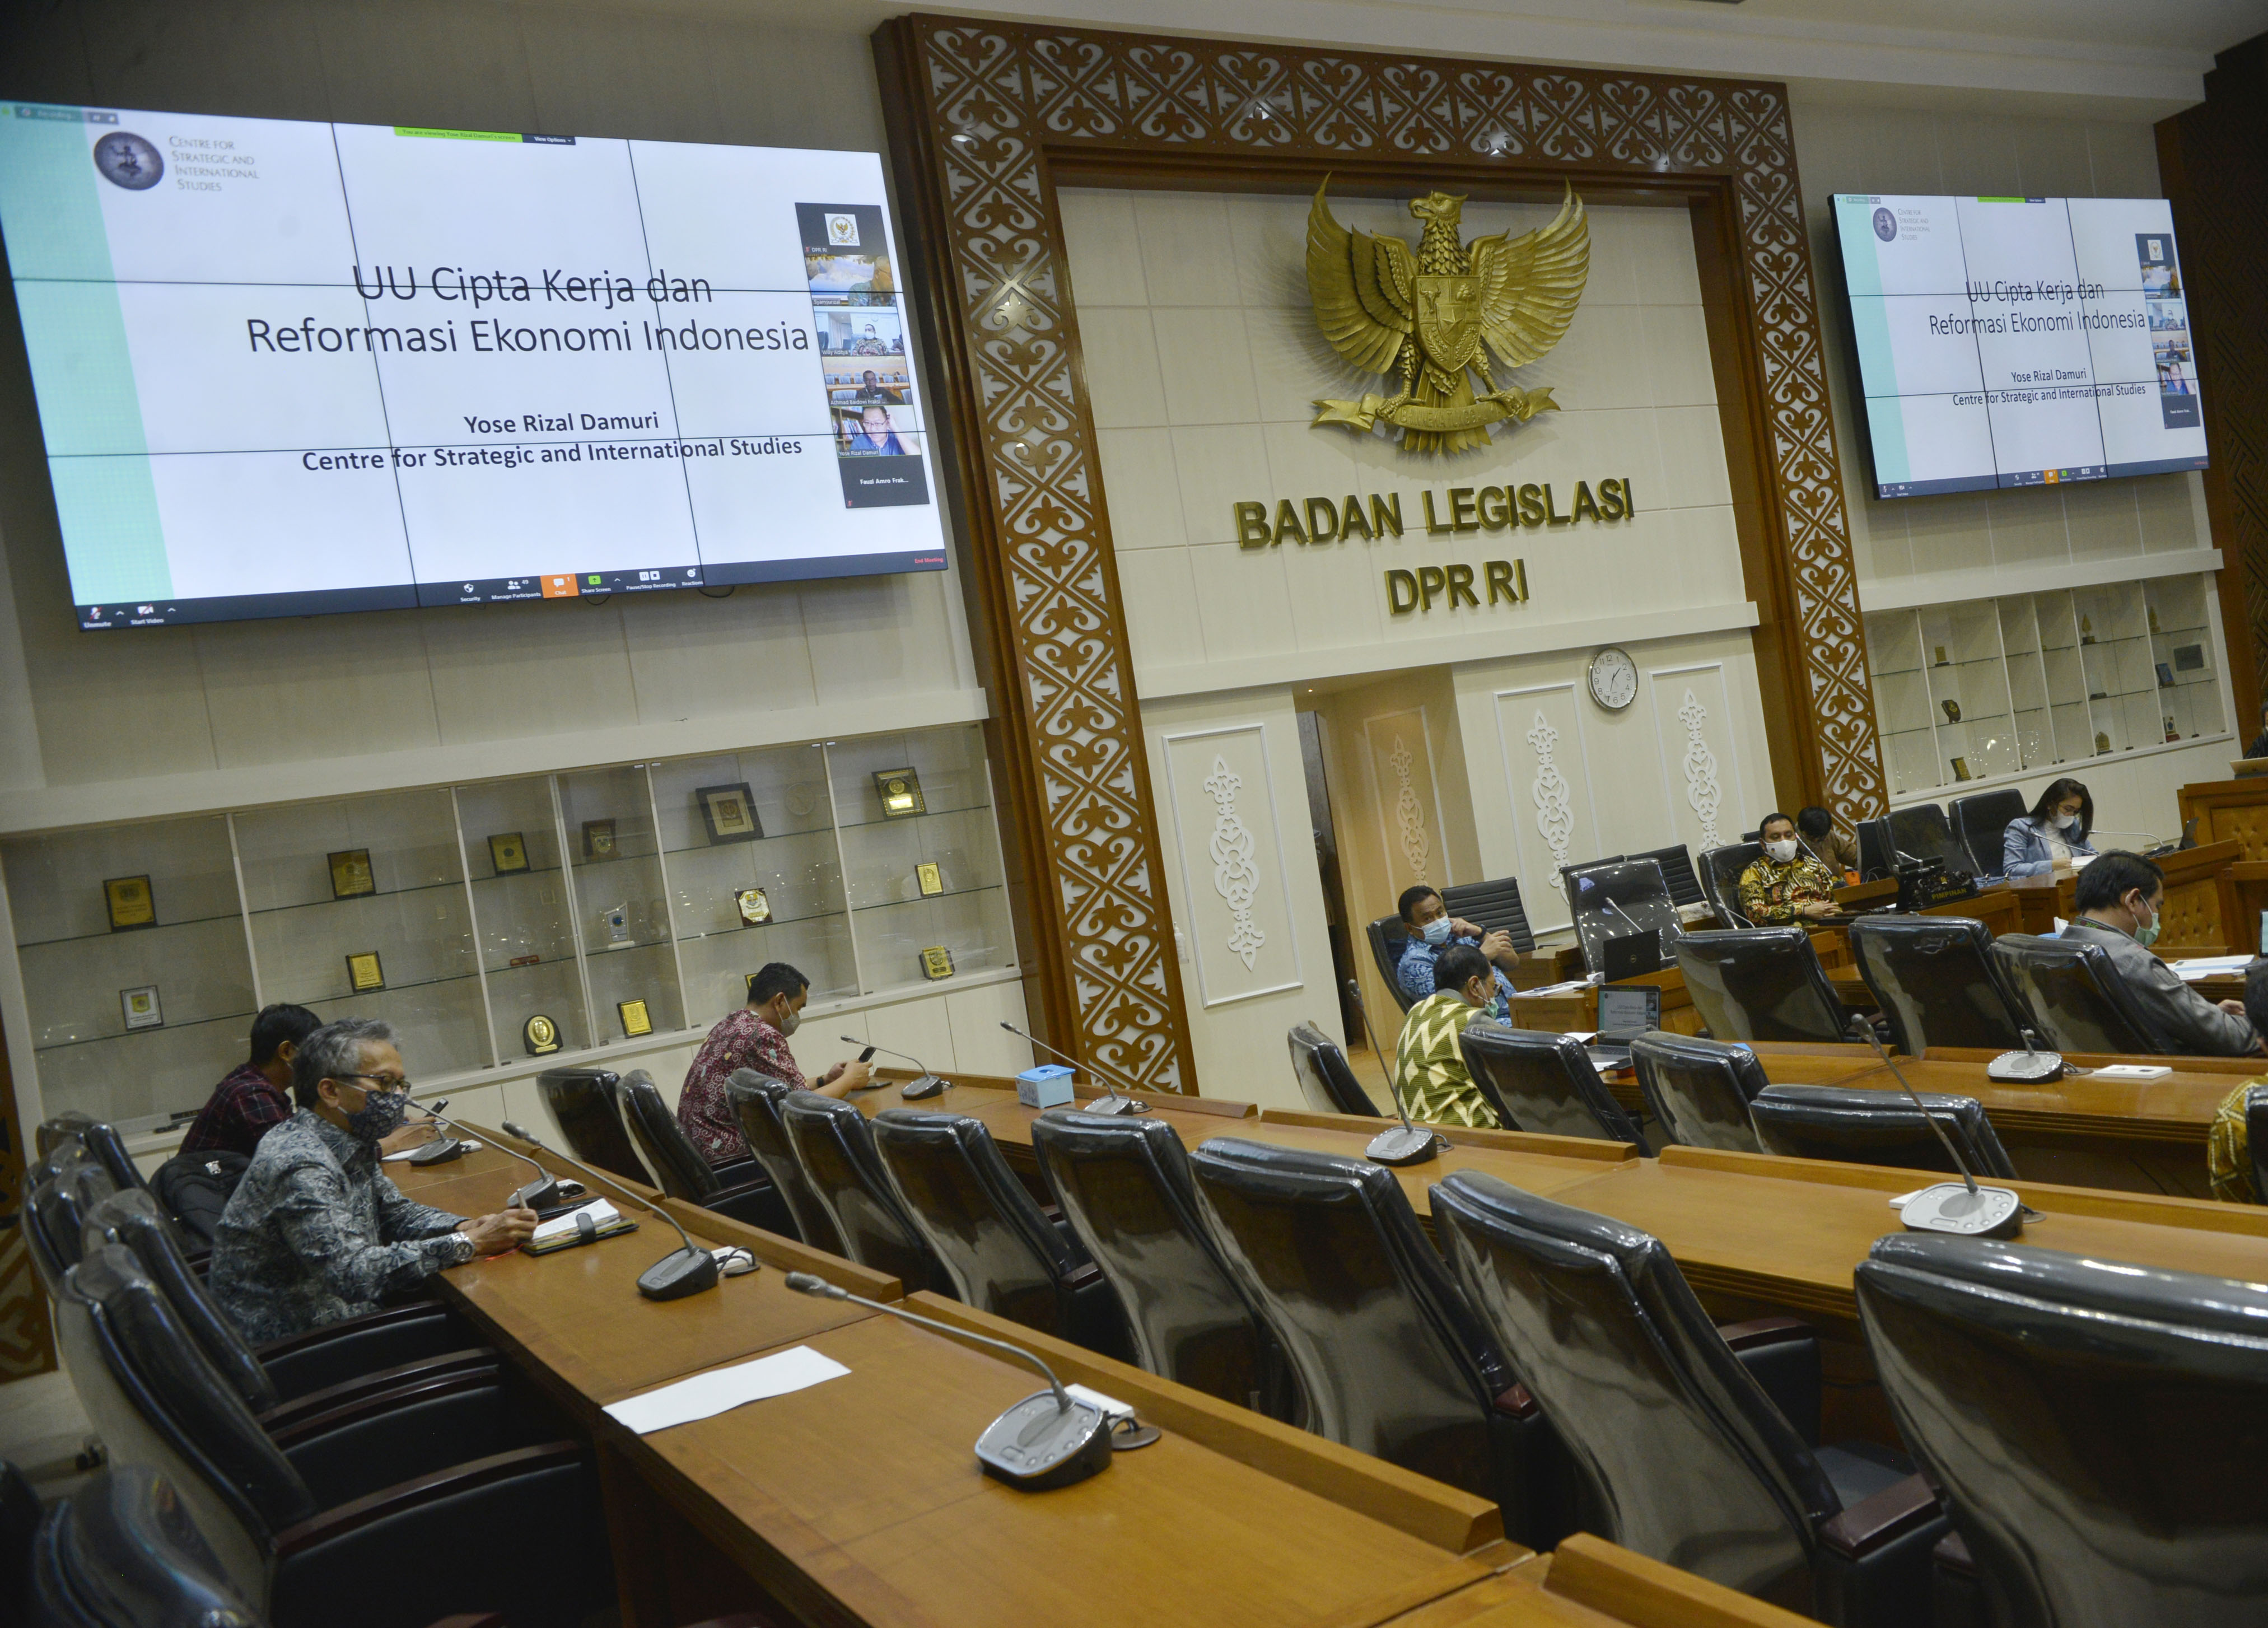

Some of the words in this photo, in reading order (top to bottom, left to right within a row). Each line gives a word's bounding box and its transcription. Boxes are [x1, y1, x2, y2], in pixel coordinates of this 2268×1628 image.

[213, 140, 234, 150] FOR
[232, 155, 254, 165] AND
[352, 265, 416, 300] UU
[431, 267, 530, 309] Cipta
[543, 269, 634, 310] Kerja
[647, 269, 712, 302] dan
[1966, 281, 1991, 302] UU
[1995, 280, 2033, 306] Cipta
[2036, 279, 2074, 305] Kerja
[2078, 278, 2104, 300] dan
[246, 316, 457, 352] Reformasi
[470, 318, 632, 352] Ekonomi
[643, 319, 809, 351] Indonesia
[1929, 313, 2007, 335] Reformasi
[2011, 311, 2074, 332] Ekonomi
[2077, 309, 2146, 330] Indonesia
[2011, 371, 2032, 383] Yose
[2033, 369, 2054, 382] Rizal
[2056, 367, 2087, 380] Damuri
[1953, 394, 1983, 406] Centre
[1985, 391, 1999, 404] for
[2001, 389, 2040, 404] Strategic
[2041, 388, 2057, 401] and
[2059, 385, 2115, 399] International
[2116, 383, 2146, 396] Studies
[463, 416, 516, 433] Yose
[523, 413, 573, 432] Rizal
[581, 412, 659, 431] Damuri
[302, 451, 384, 471] Centre
[391, 448, 426, 468] for
[433, 445, 535, 468] Strategic
[541, 443, 582, 463] and
[588, 439, 725, 461] International
[730, 437, 802, 456] Studies
[1234, 491, 1404, 549] BADAN
[1421, 478, 1636, 534] LEGISLASI
[1384, 562, 1480, 614] DPR
[1482, 558, 1530, 605] RI
[1931, 888, 1967, 900] PIMPINAN
